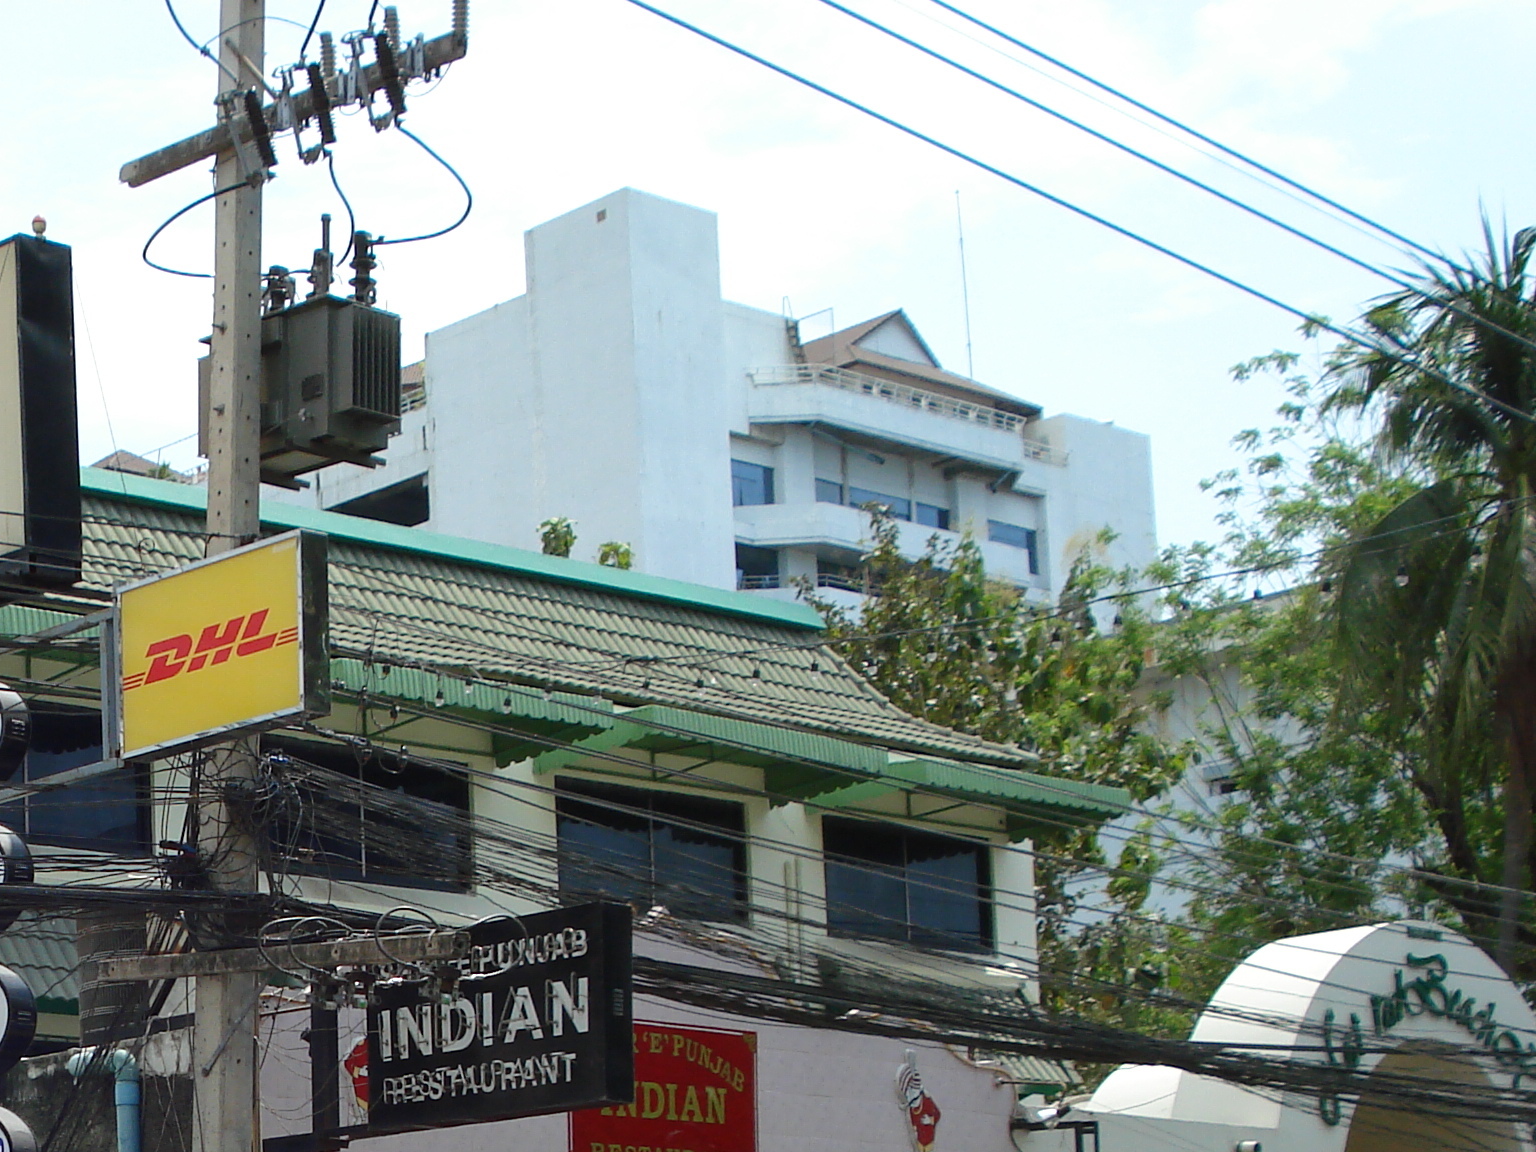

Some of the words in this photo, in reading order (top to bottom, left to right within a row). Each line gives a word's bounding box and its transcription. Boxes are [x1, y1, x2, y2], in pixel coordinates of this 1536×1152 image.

[144, 608, 278, 685] DHL
[379, 974, 589, 1062] INDIAN
[383, 1051, 576, 1105] RESTAURANT
[673, 1034, 745, 1092] PUNJAB
